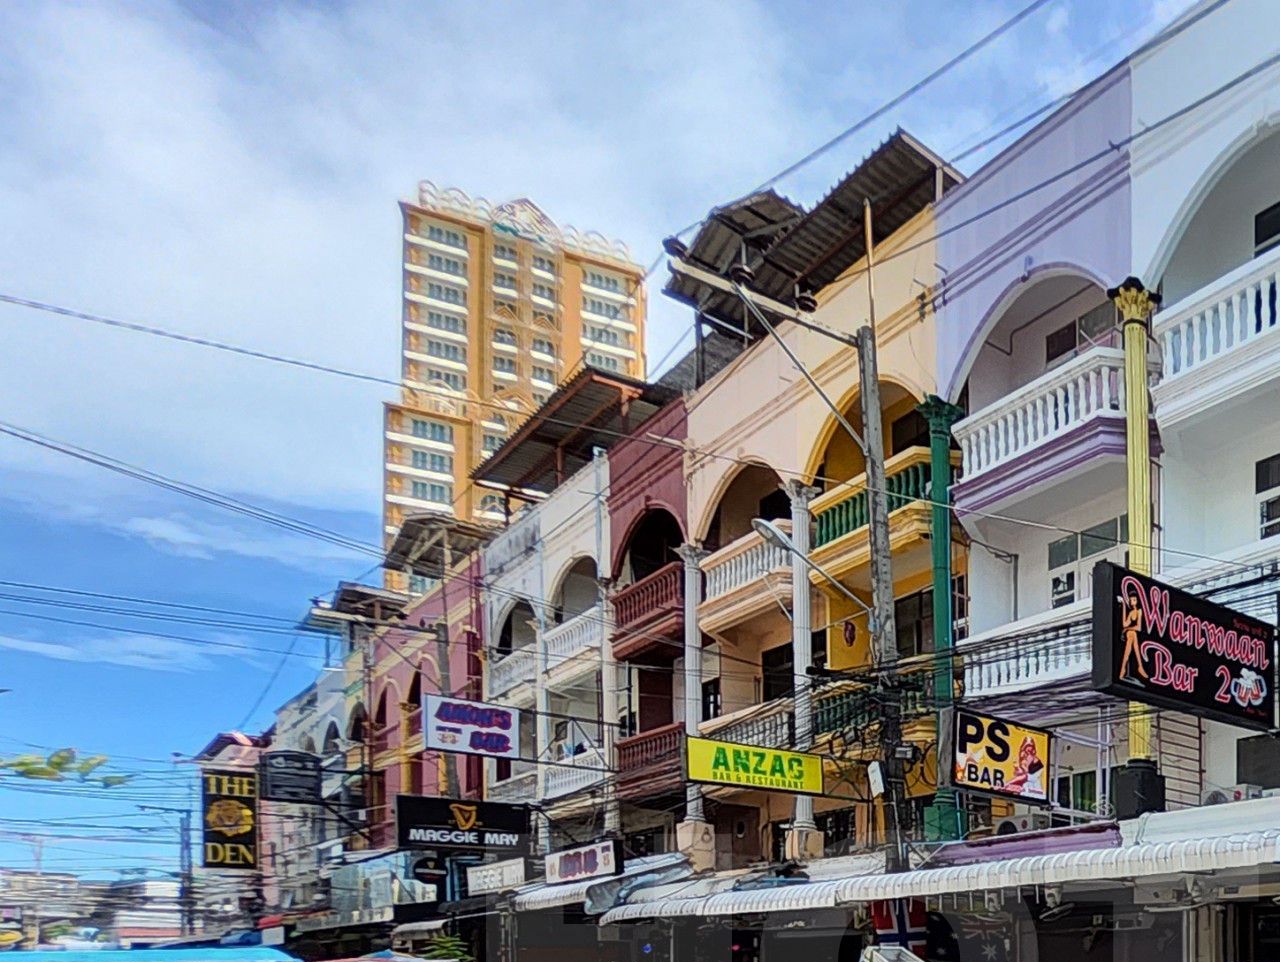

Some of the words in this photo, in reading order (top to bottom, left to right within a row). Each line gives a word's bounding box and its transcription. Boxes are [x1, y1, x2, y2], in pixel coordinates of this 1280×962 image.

[1120, 576, 1269, 670] Wanwaan
[1141, 640, 1198, 693] Bar
[1215, 665, 1232, 703] 2
[958, 712, 1010, 762] PS
[712, 746, 804, 780] ANZAC
[205, 774, 256, 797] THE
[713, 771, 731, 781] BAR
[745, 775, 804, 789] RESTAURANT
[967, 764, 1005, 787] BAR
[408, 828, 479, 844] MAGGIE
[484, 832, 519, 846] MAY
[204, 843, 255, 864] DEN
